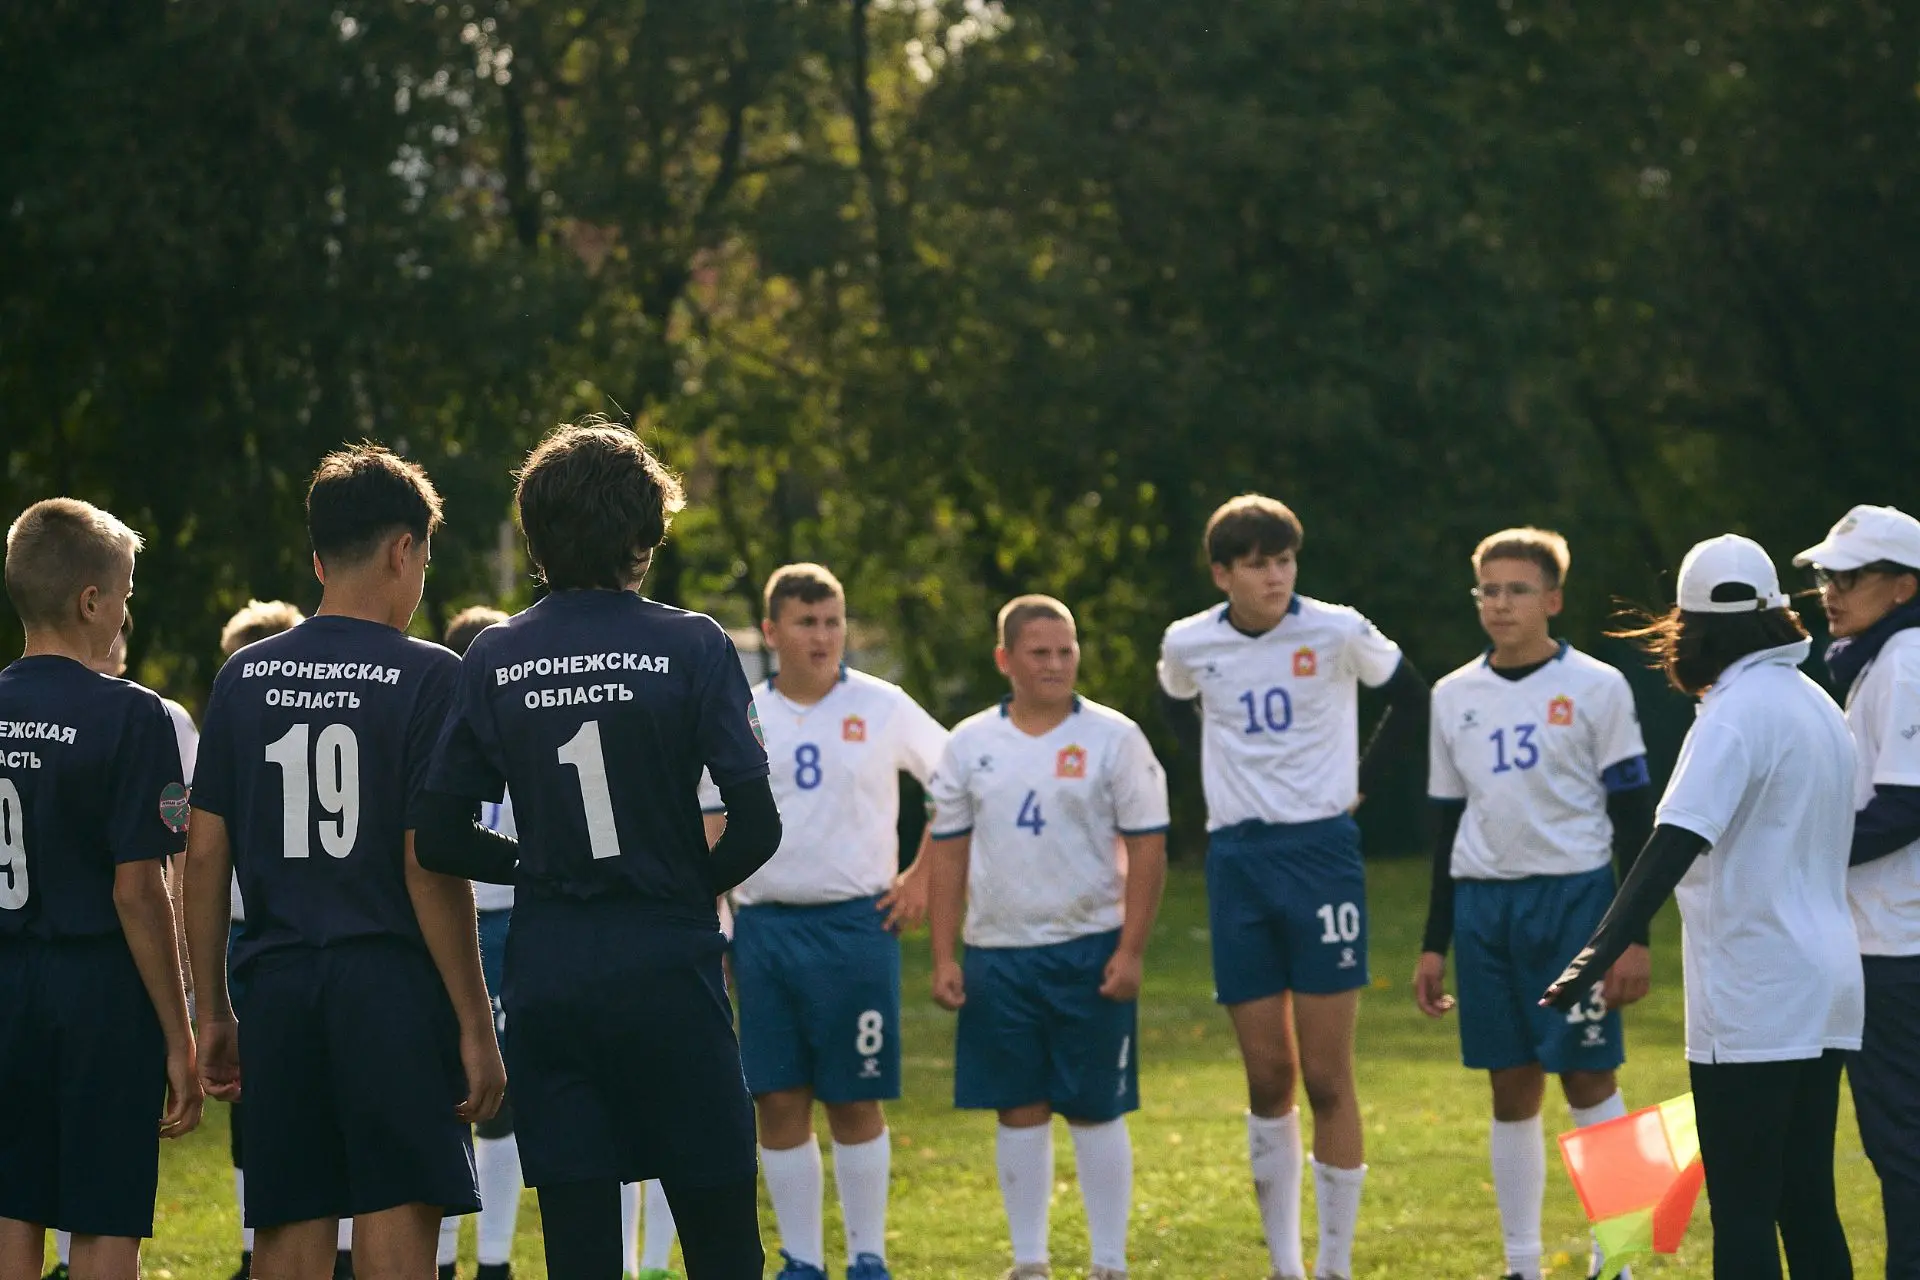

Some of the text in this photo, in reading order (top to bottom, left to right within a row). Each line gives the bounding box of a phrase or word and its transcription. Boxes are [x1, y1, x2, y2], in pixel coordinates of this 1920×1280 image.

[242, 660, 401, 685] ВОРОНЕЖСКАЯ
[496, 652, 670, 685] ВОРОНЕЖСКАЯ
[265, 688, 361, 709] ОБЛАСТЬ
[524, 683, 634, 709] ОБЛАСТЬ
[1239, 687, 1293, 734] 10
[793, 743, 822, 790] 8
[1489, 723, 1539, 774] 13
[265, 723, 360, 859] 19
[557, 720, 621, 859] 1
[1016, 789, 1047, 836] 4
[0, 777, 29, 911] 9
[1316, 901, 1360, 944] 10
[856, 1009, 883, 1055] 8
